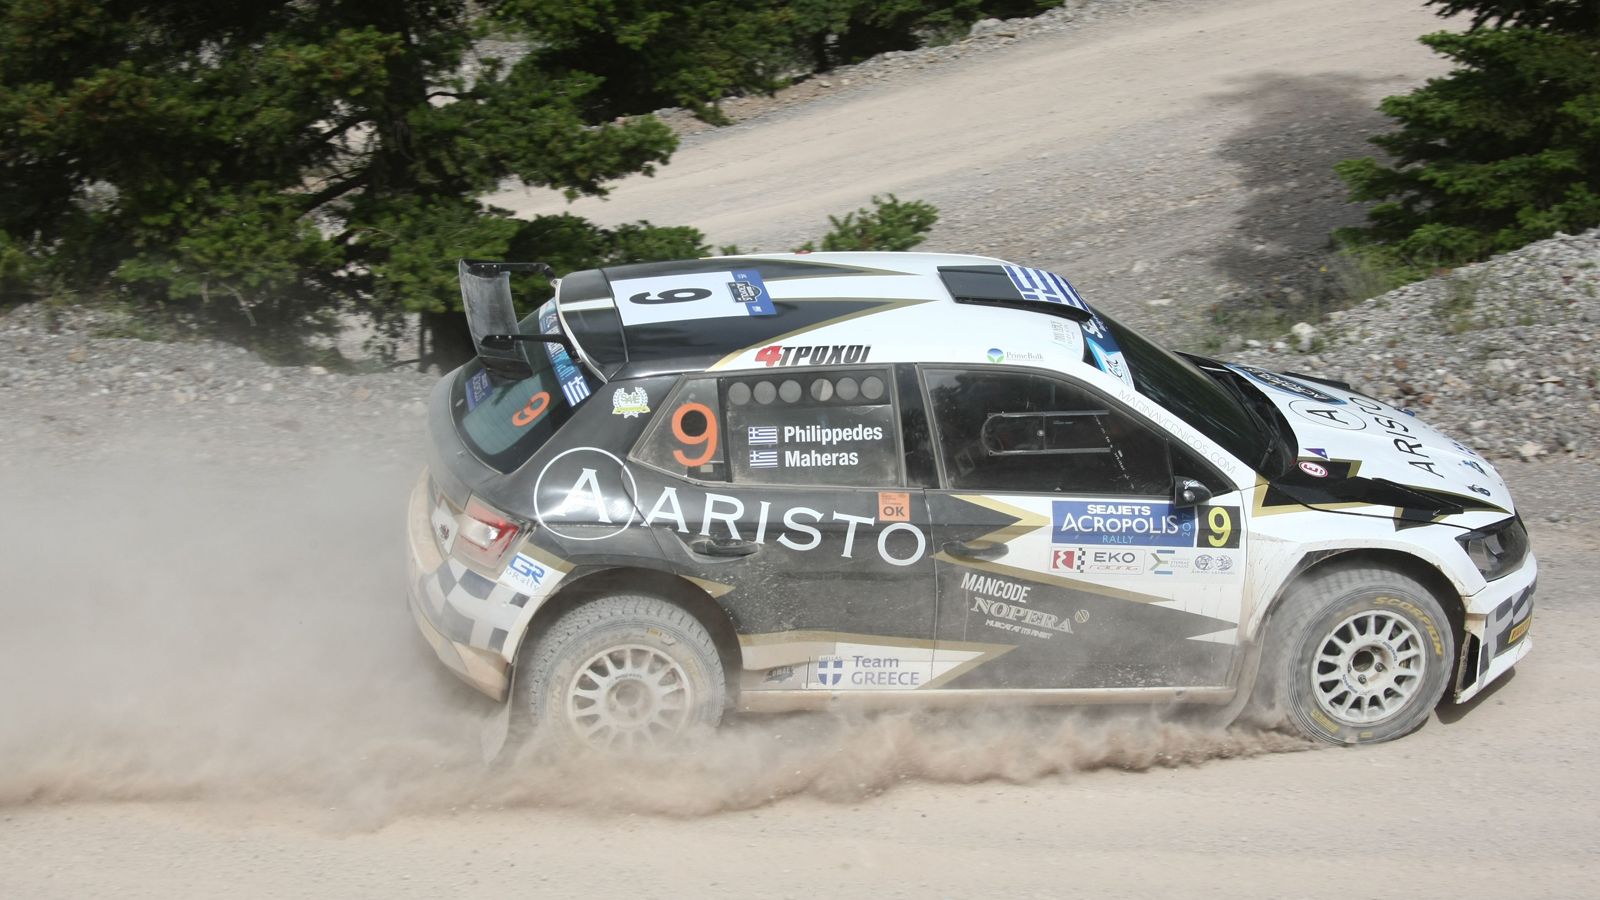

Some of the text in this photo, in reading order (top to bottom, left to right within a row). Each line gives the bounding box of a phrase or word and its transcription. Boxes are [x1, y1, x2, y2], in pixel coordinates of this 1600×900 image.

[629, 287, 713, 305] 9
[671, 402, 719, 467] 9
[784, 424, 883, 447] Philippedes
[785, 449, 859, 468] Maheras
[549, 467, 612, 523] A
[883, 506, 905, 517] OK
[1087, 504, 1151, 516] SEAJETS
[640, 486, 926, 566] ARISTO
[1061, 512, 1179, 535] ACROPOLIS
[1208, 506, 1231, 547] 9
[1102, 534, 1134, 544] RALLY
[1093, 551, 1136, 563] EKO
[961, 572, 1031, 603] MANCODE
[970, 597, 1074, 634] NOPERA
[1373, 596, 1444, 656] SCORPION
[852, 655, 899, 668] Team
[851, 672, 920, 686] GREECE
